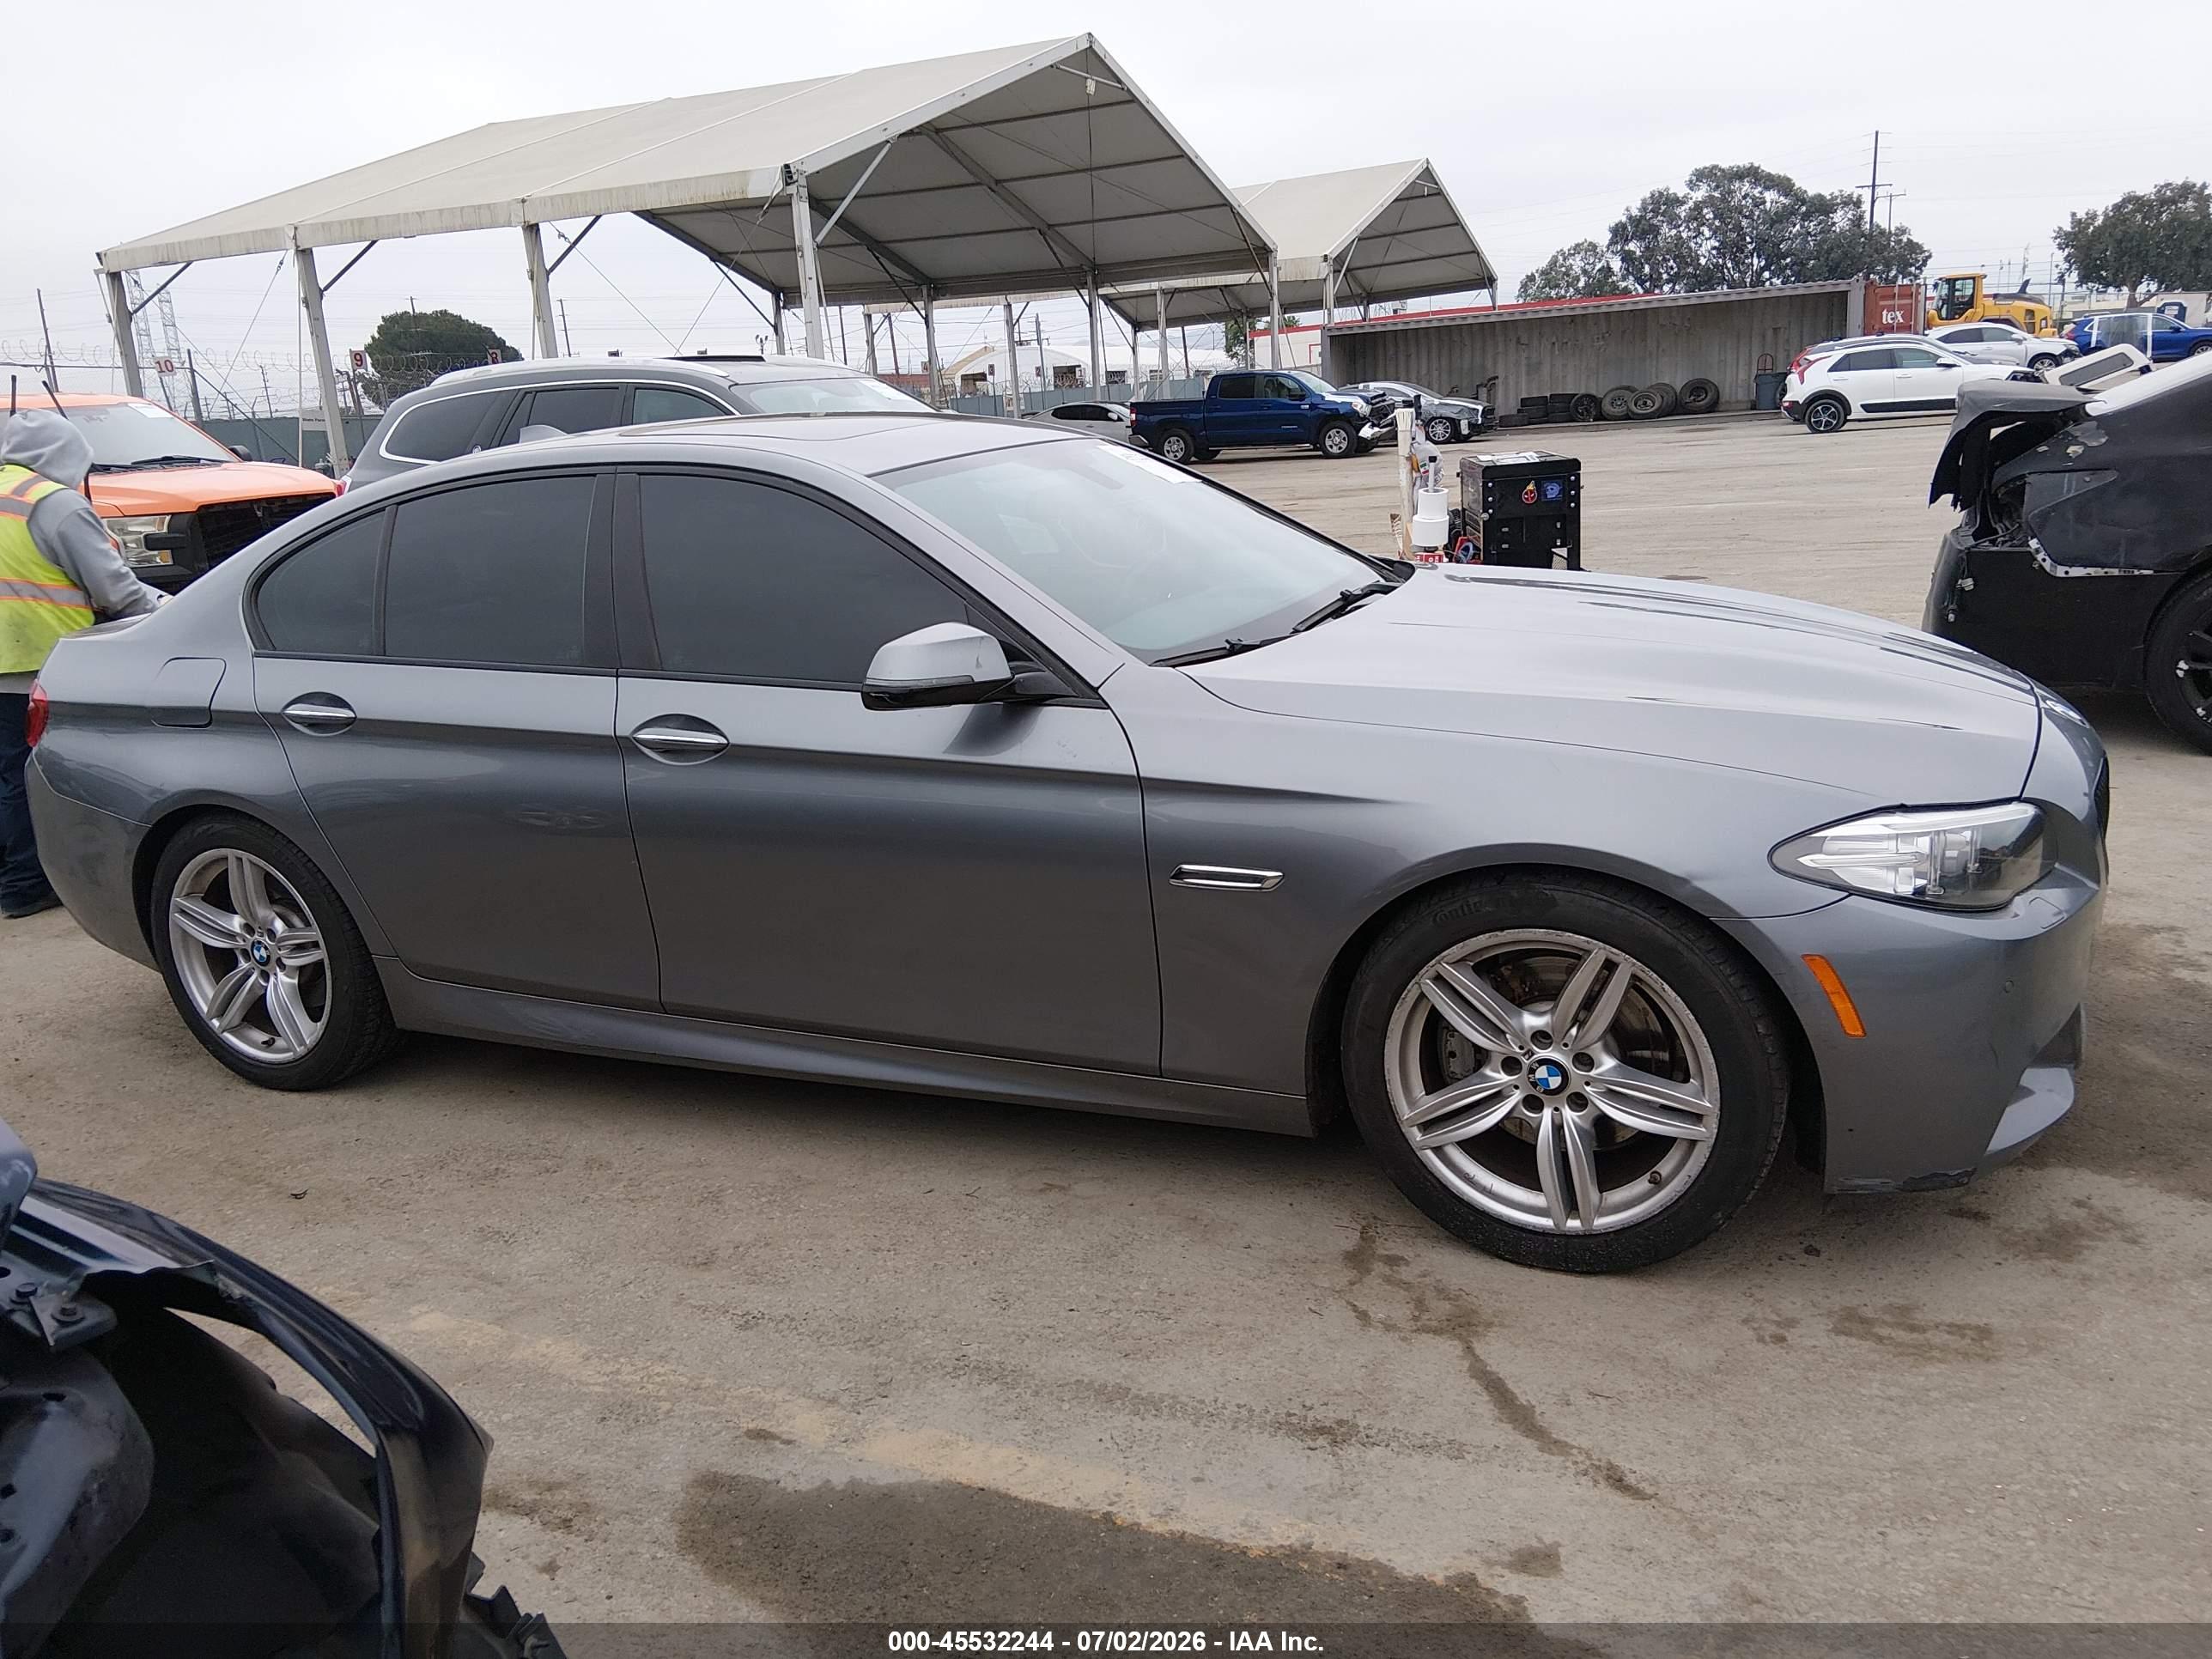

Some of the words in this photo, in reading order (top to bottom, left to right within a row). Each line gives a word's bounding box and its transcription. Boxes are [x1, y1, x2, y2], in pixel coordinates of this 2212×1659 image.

[1881, 308, 1905, 325] tex
[155, 359, 174, 374] 10
[354, 352, 363, 367] 9
